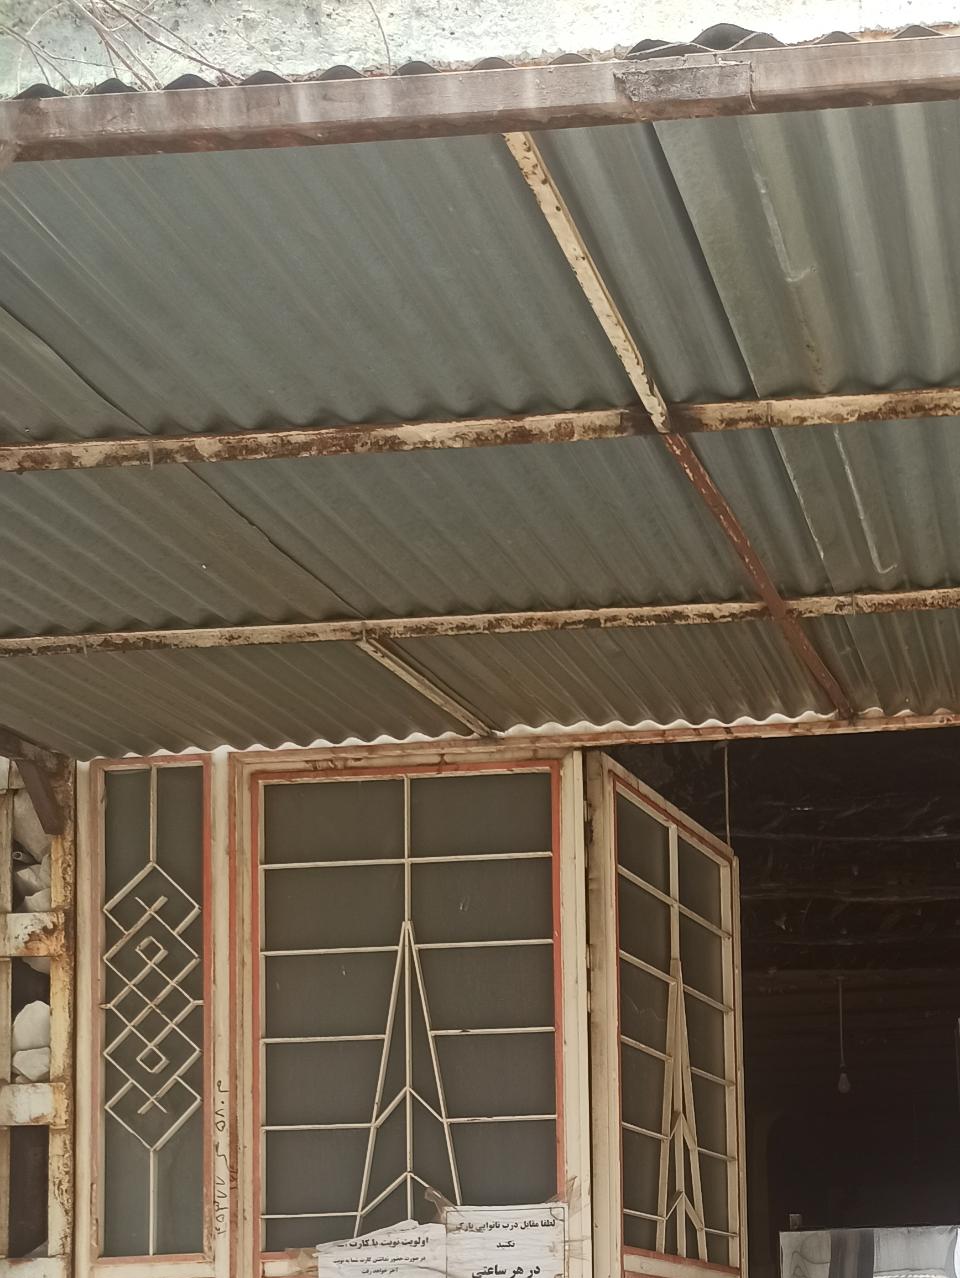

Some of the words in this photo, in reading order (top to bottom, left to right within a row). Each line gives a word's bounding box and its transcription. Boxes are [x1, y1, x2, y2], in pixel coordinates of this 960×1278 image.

[502, 1221, 519, 1230] درب
[541, 1219, 556, 1227] لطفا
[401, 1236, 429, 1247] اولویت
[472, 1264, 507, 1278] ساعتی
[510, 1265, 524, 1278] هر
[526, 1265, 541, 1278] در
